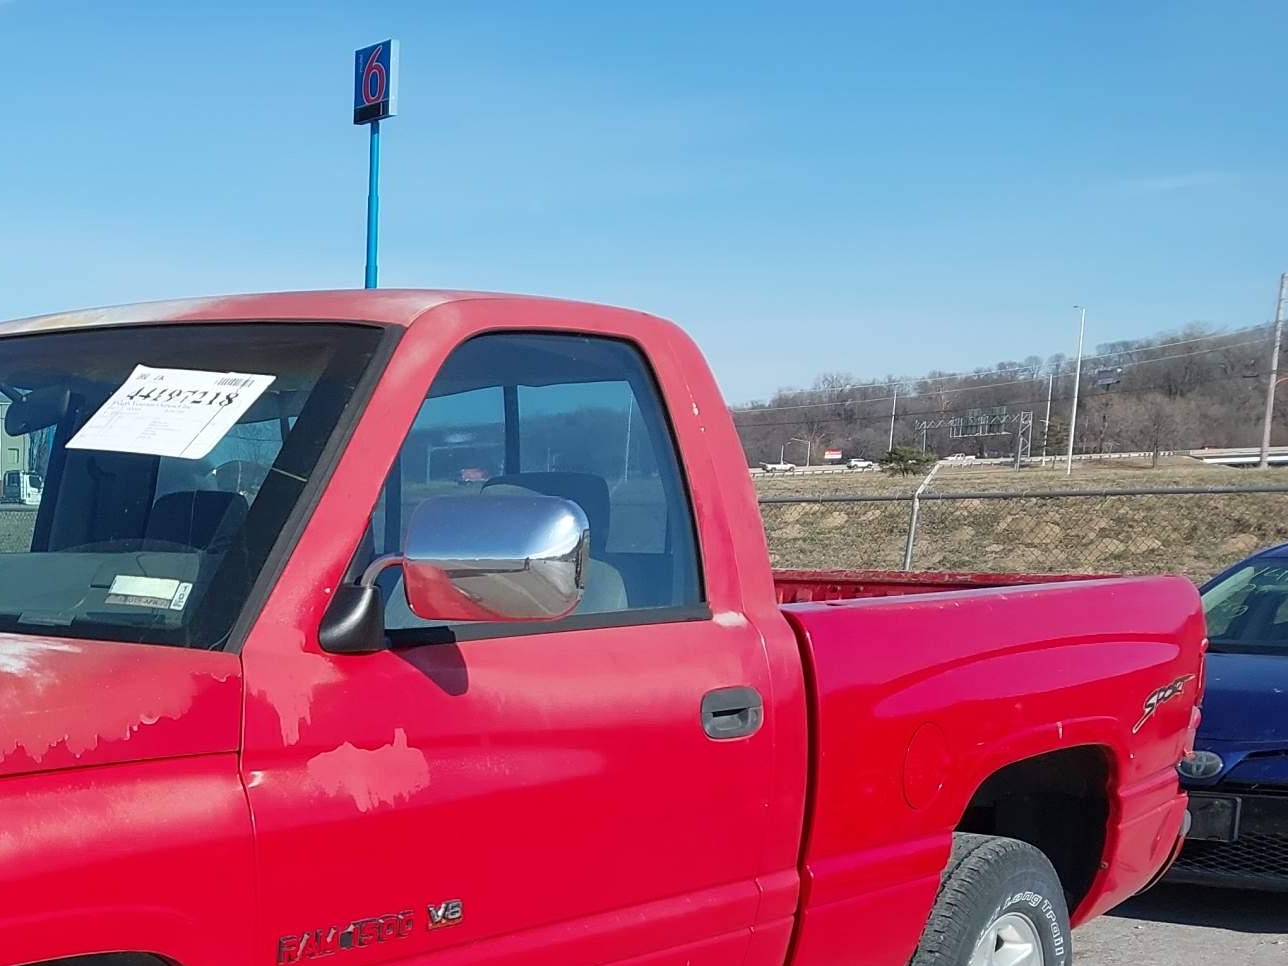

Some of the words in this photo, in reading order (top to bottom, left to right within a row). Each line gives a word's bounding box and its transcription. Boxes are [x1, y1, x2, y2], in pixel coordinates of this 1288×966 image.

[362, 45, 386, 105] 6
[127, 386, 239, 407] 44197218
[1003, 891, 1042, 910] Long
[428, 899, 462, 929] V8
